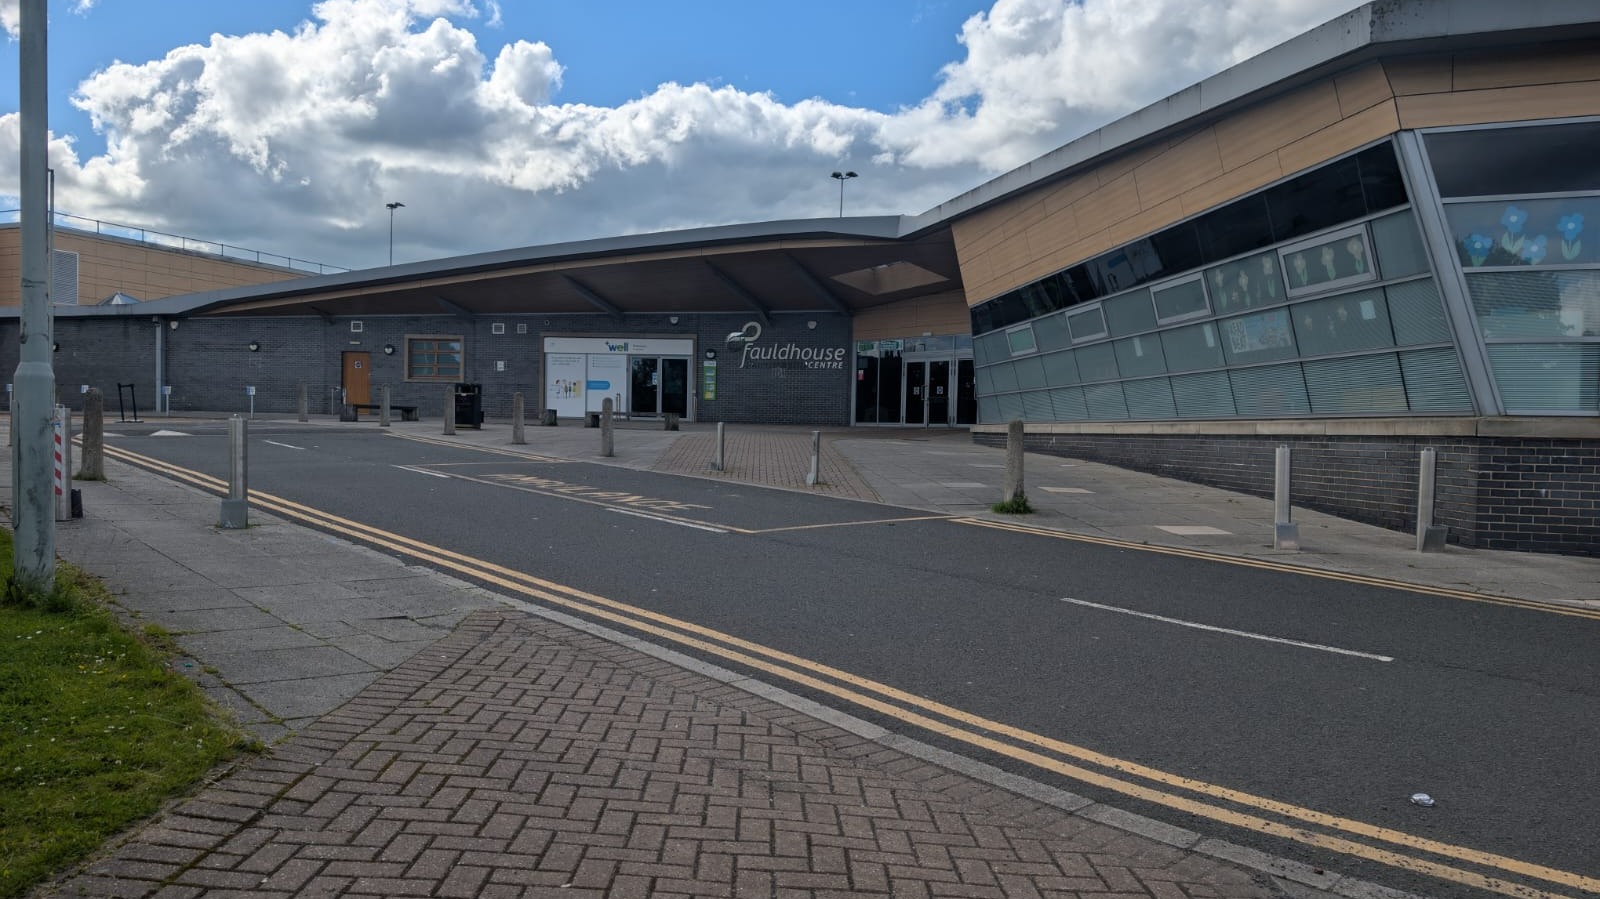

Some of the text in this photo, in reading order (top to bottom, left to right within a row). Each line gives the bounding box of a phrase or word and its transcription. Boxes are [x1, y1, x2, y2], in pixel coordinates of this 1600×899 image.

[608, 342, 629, 352] well
[739, 343, 846, 369] fauldhouse
[807, 361, 844, 369] CENTRE
